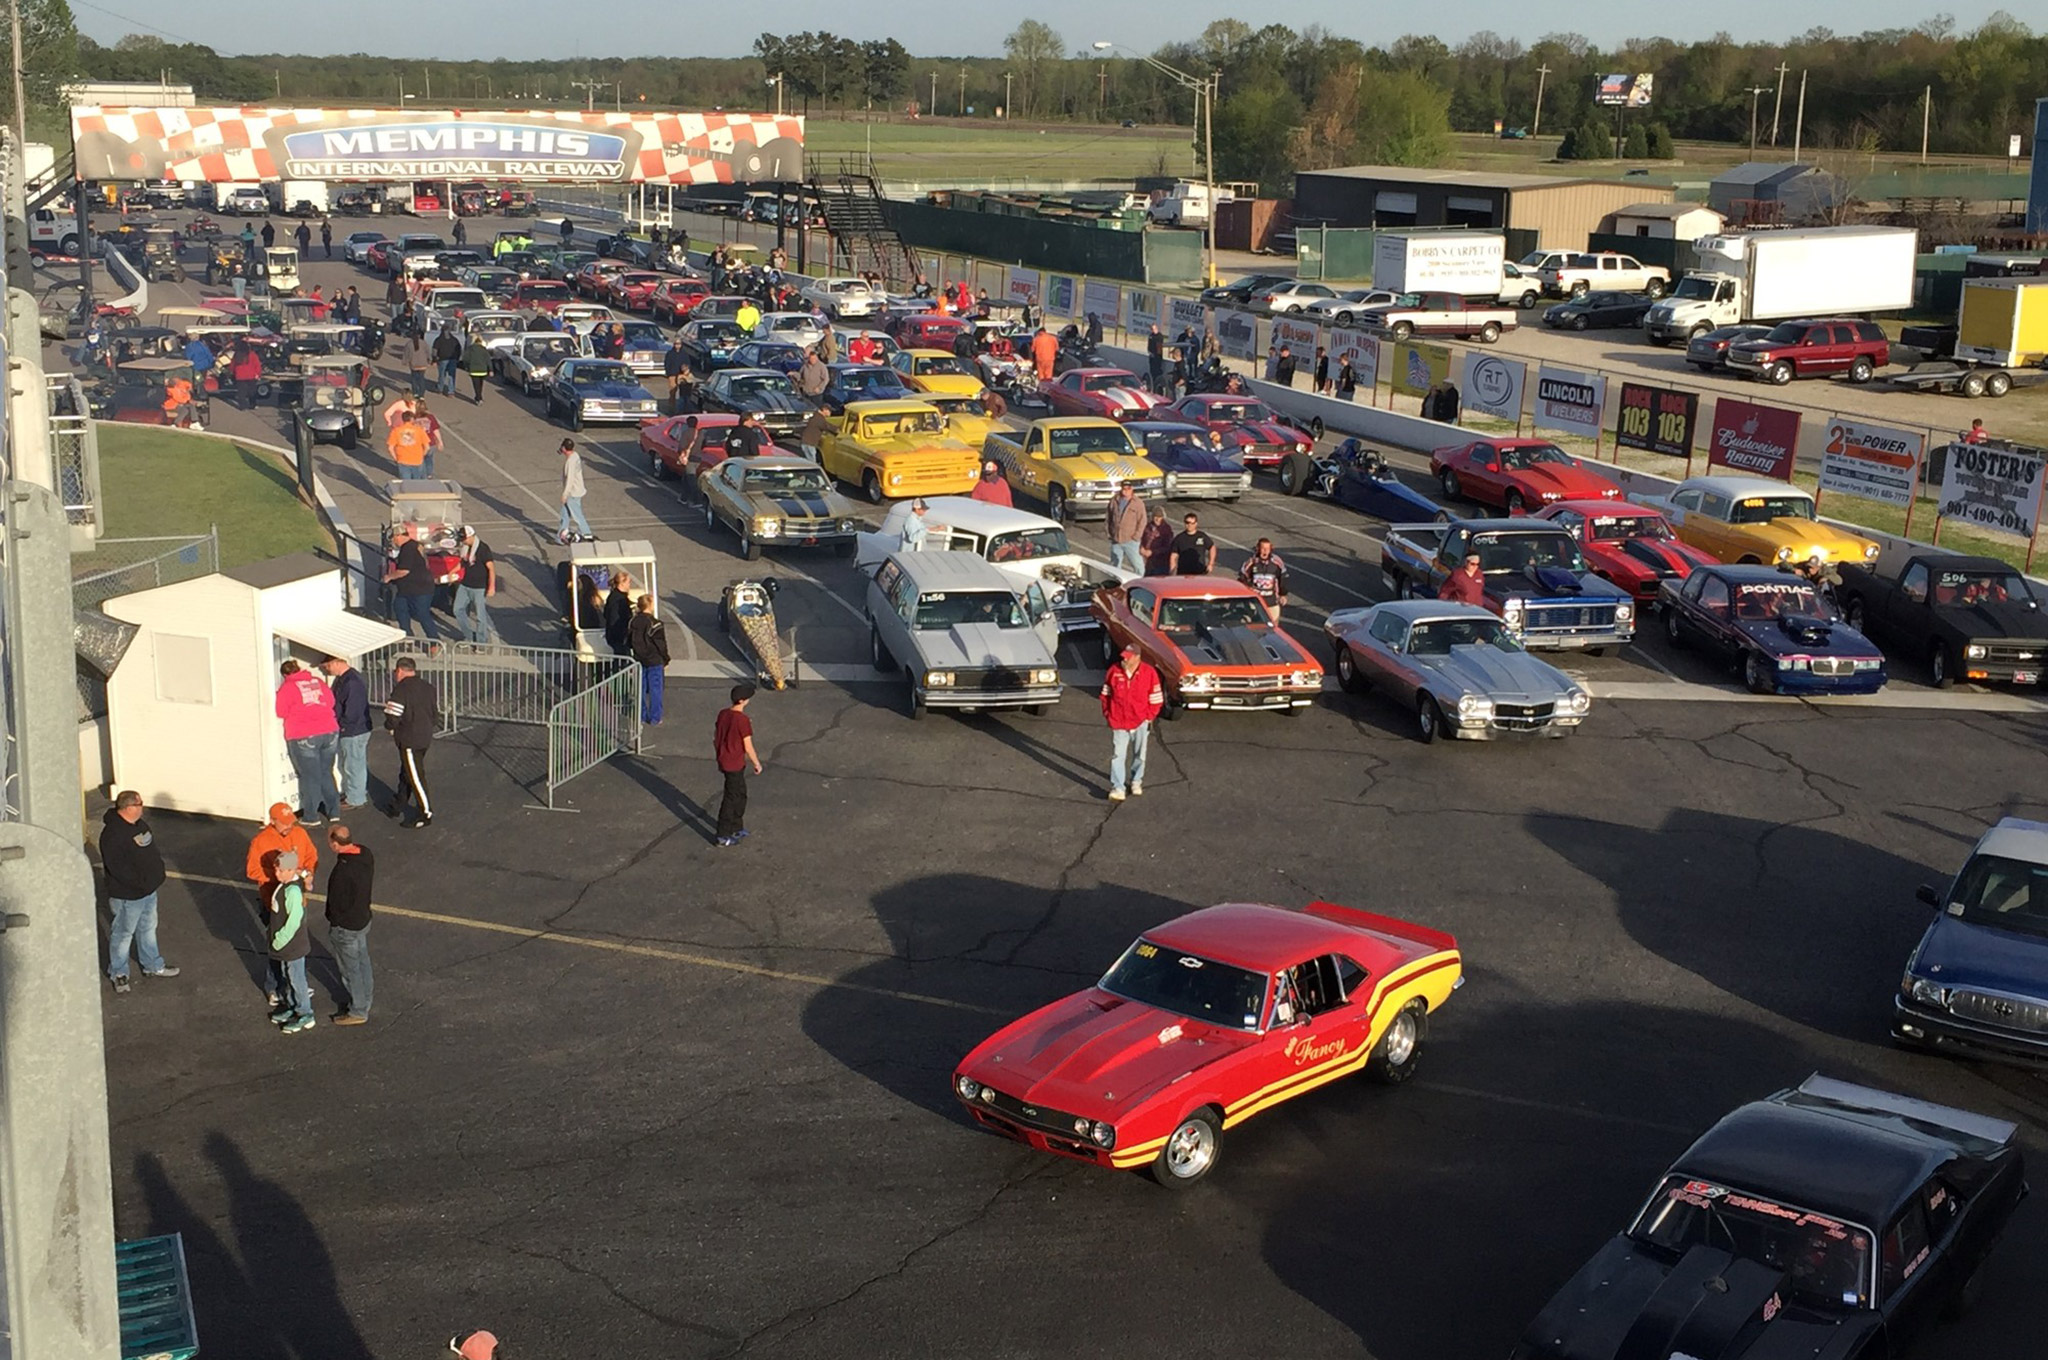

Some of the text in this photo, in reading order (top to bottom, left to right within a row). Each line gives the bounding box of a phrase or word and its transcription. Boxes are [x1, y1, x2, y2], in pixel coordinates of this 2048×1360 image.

[322, 128, 590, 157] MEMPHIS
[292, 160, 623, 176] INTERNATIONAL RACEWAY
[1541, 382, 1592, 405] LINCOLN
[1624, 387, 1652, 407] ROCK
[1660, 393, 1687, 415] ROCK
[1550, 402, 1594, 423] WELDERS
[1622, 407, 1650, 437] 103
[1658, 412, 1686, 444] 103
[1717, 427, 1787, 457] Budweiser
[1862, 435, 1907, 454] POWER
[1954, 446, 2036, 485] FOSTER'S
[1741, 584, 1815, 596] PONTIAC
[1294, 1034, 1346, 1066] Fancy
